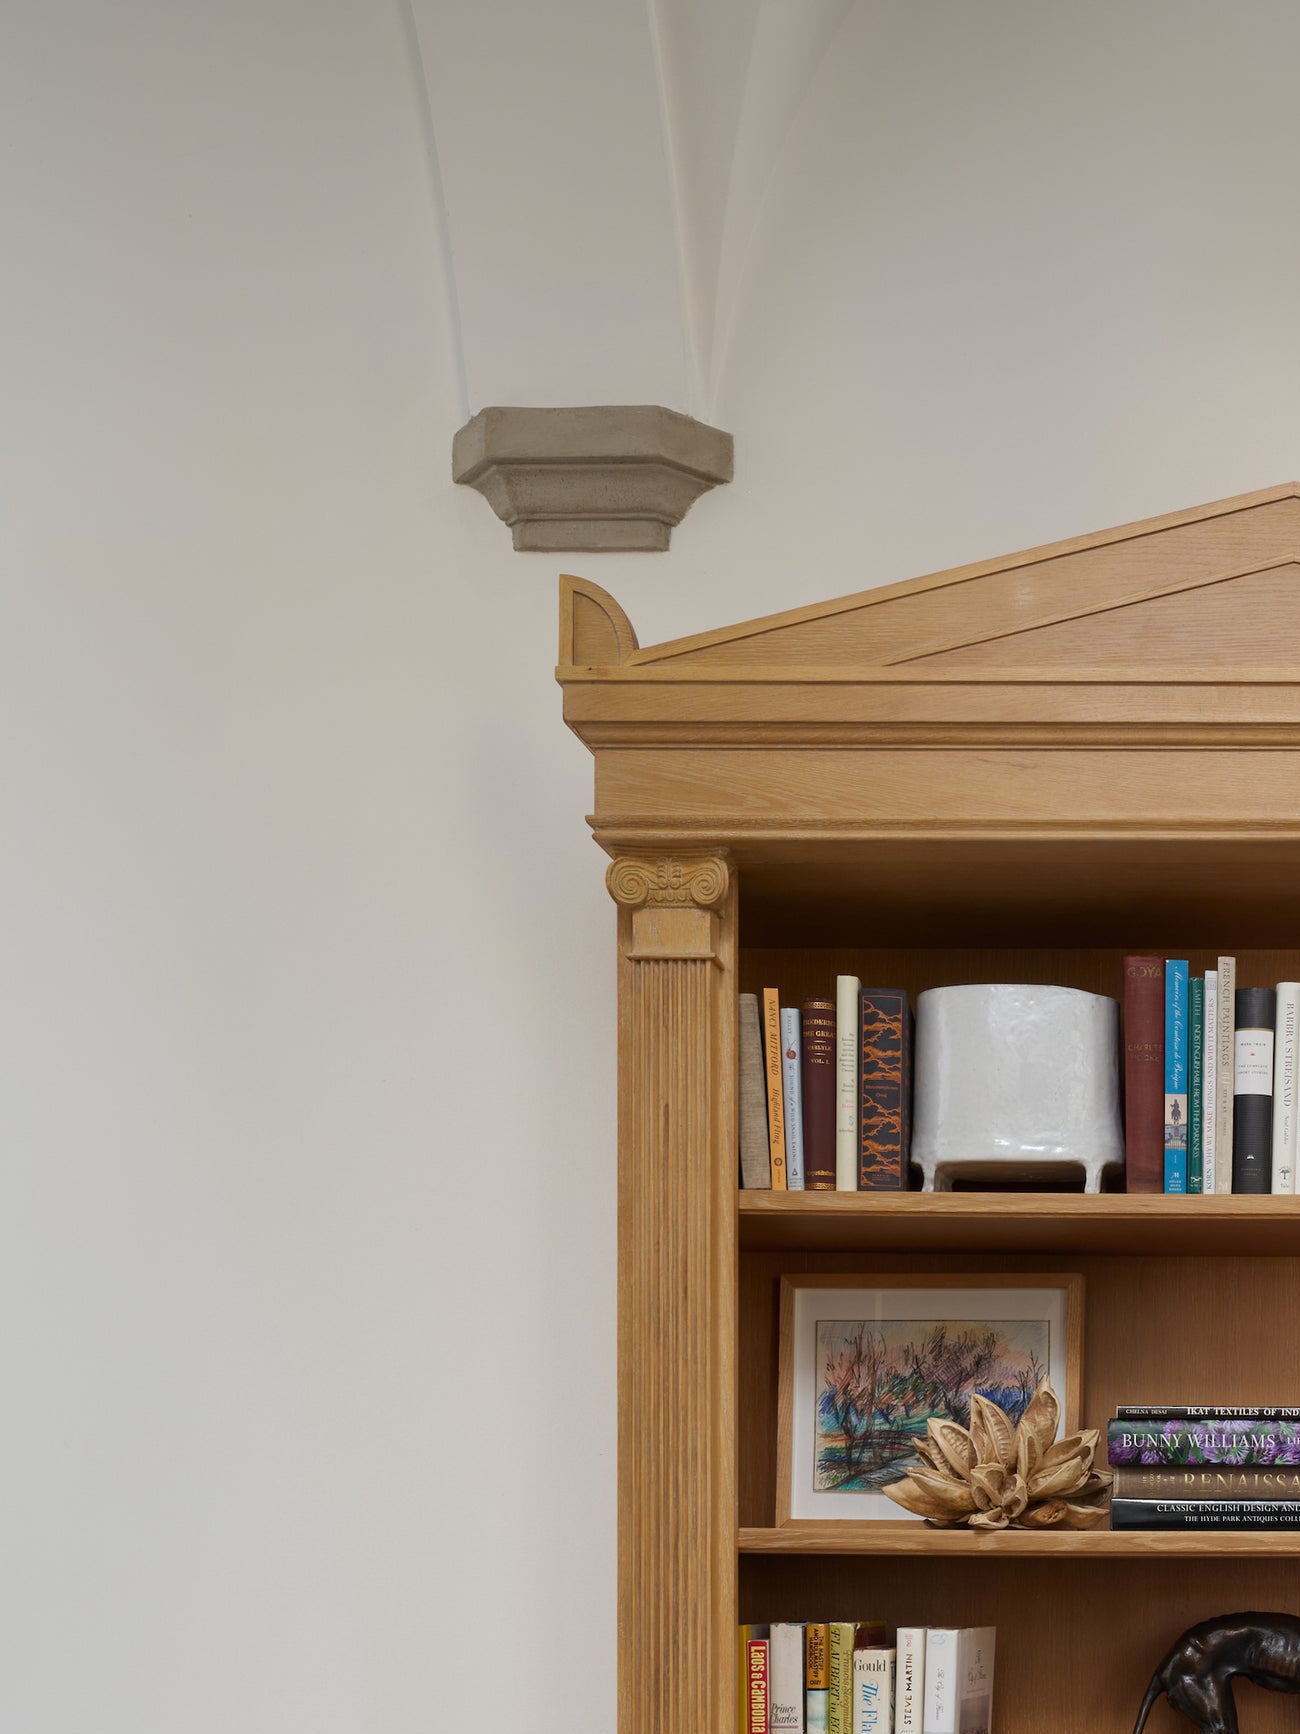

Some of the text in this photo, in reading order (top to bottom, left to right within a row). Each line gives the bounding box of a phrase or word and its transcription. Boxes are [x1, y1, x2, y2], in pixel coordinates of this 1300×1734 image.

[768, 999, 778, 1029] NANCY
[1221, 961, 1231, 1067] FRENCH PAINTINGS
[770, 1032, 780, 1076] MITFORD
[772, 1088, 782, 1124] Highland
[1206, 1081, 1214, 1109] THINGS
[1206, 1111, 1214, 1132] MAKE
[1206, 1134, 1213, 1147] WE
[1187, 1407, 1209, 1416] IKAT
[1214, 1407, 1259, 1417] TEXTILES
[1263, 1408, 1277, 1417] OF
[1122, 1433, 1183, 1448] BUNNY
[1187, 1434, 1276, 1448] WILLIAMS
[1156, 1504, 1197, 1513] CLASSIC
[1199, 1504, 1241, 1513] ENGLISH
[1243, 1504, 1279, 1513] DESIGN
[1184, 1515, 1198, 1523] THE
[1200, 1515, 1220, 1523] HYDE
[1222, 1515, 1241, 1523] PARK
[1242, 1515, 1278, 1524] ANTIQUES
[831, 1627, 841, 1701] FLAUBERT
[843, 1650, 852, 1685] Francis
[854, 1659, 887, 1673] Gould
[862, 1680, 880, 1705] The
[904, 1653, 913, 1725] STEVE MARTIN
[771, 1702, 797, 1714] Prince
[831, 1702, 840, 1713] in
